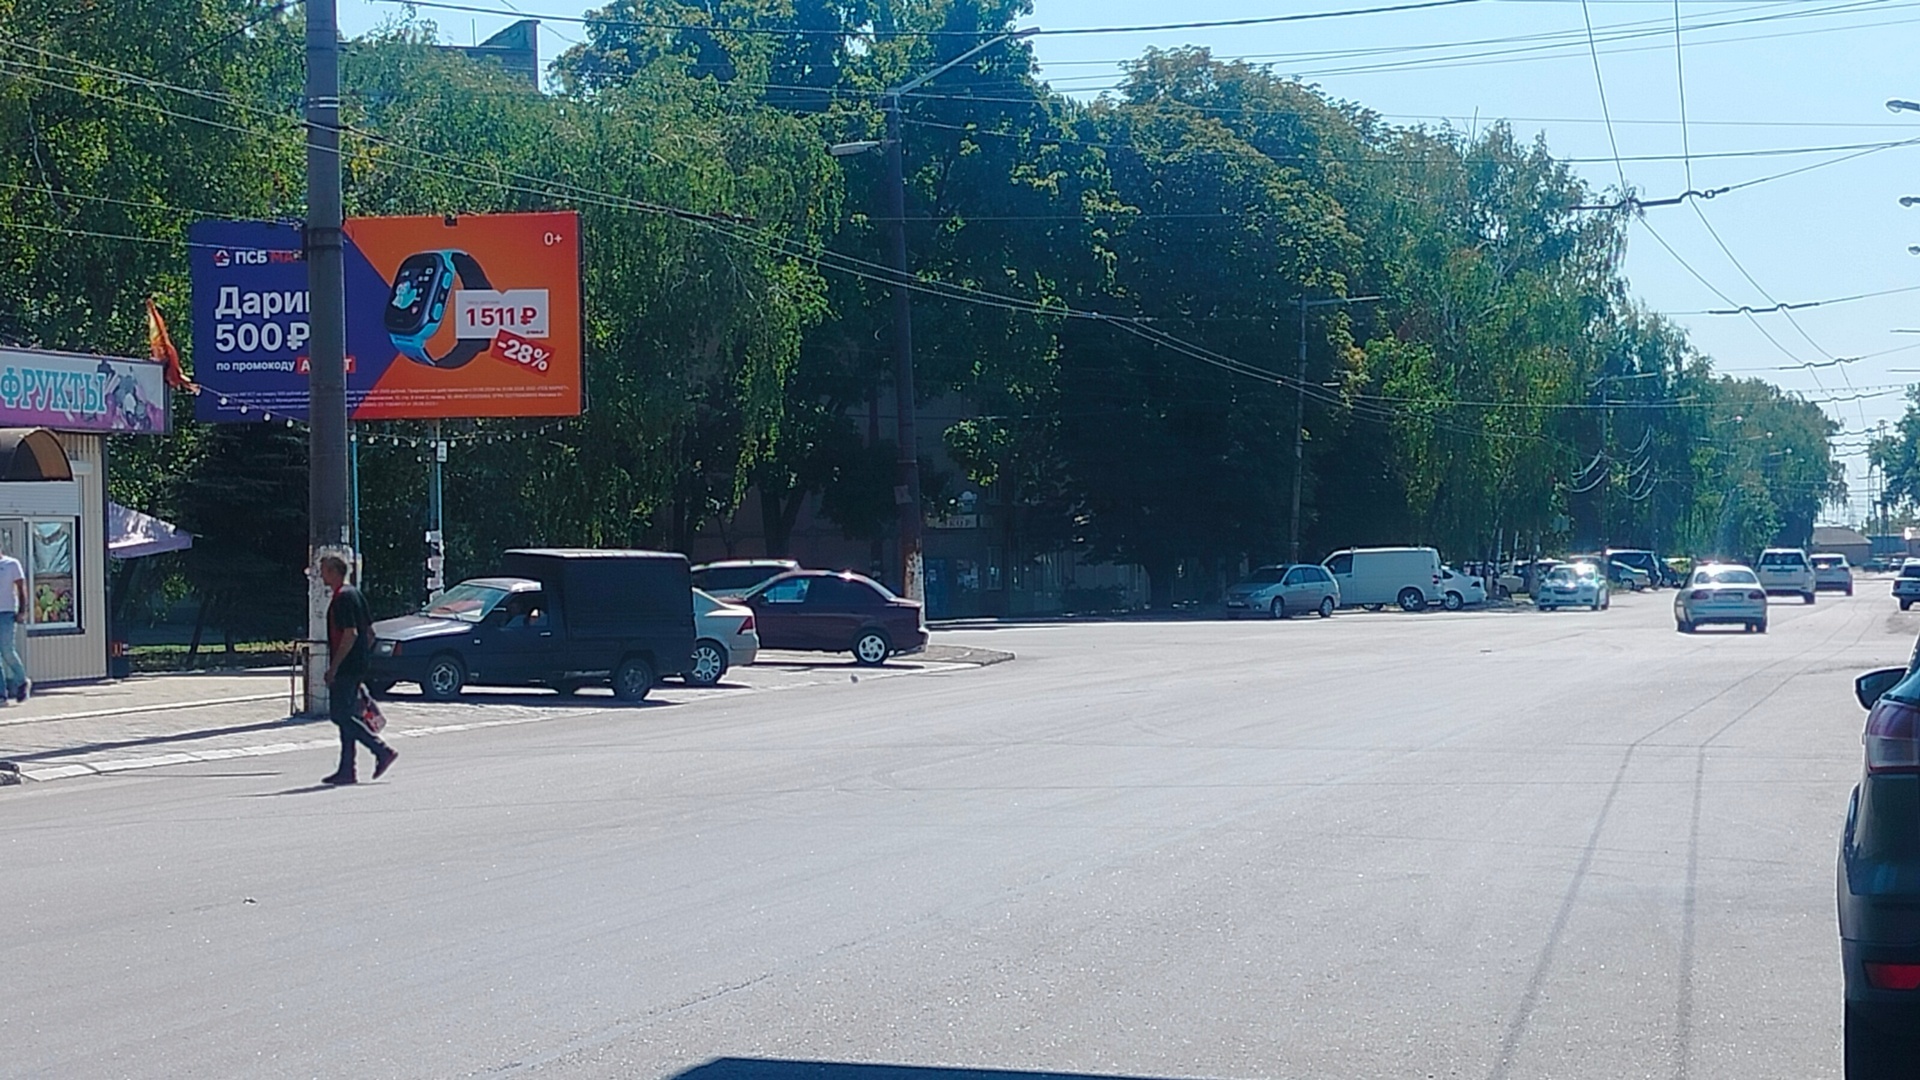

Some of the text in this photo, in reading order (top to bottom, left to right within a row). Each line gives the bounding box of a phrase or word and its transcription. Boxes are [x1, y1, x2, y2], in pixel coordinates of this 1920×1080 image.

[544, 231, 563, 246] 0+
[234, 250, 268, 265] ПСБ
[497, 339, 550, 371] -28%
[216, 362, 231, 371] по
[232, 360, 296, 373] промокоду
[0, 366, 107, 413] ФРУКТЫ
